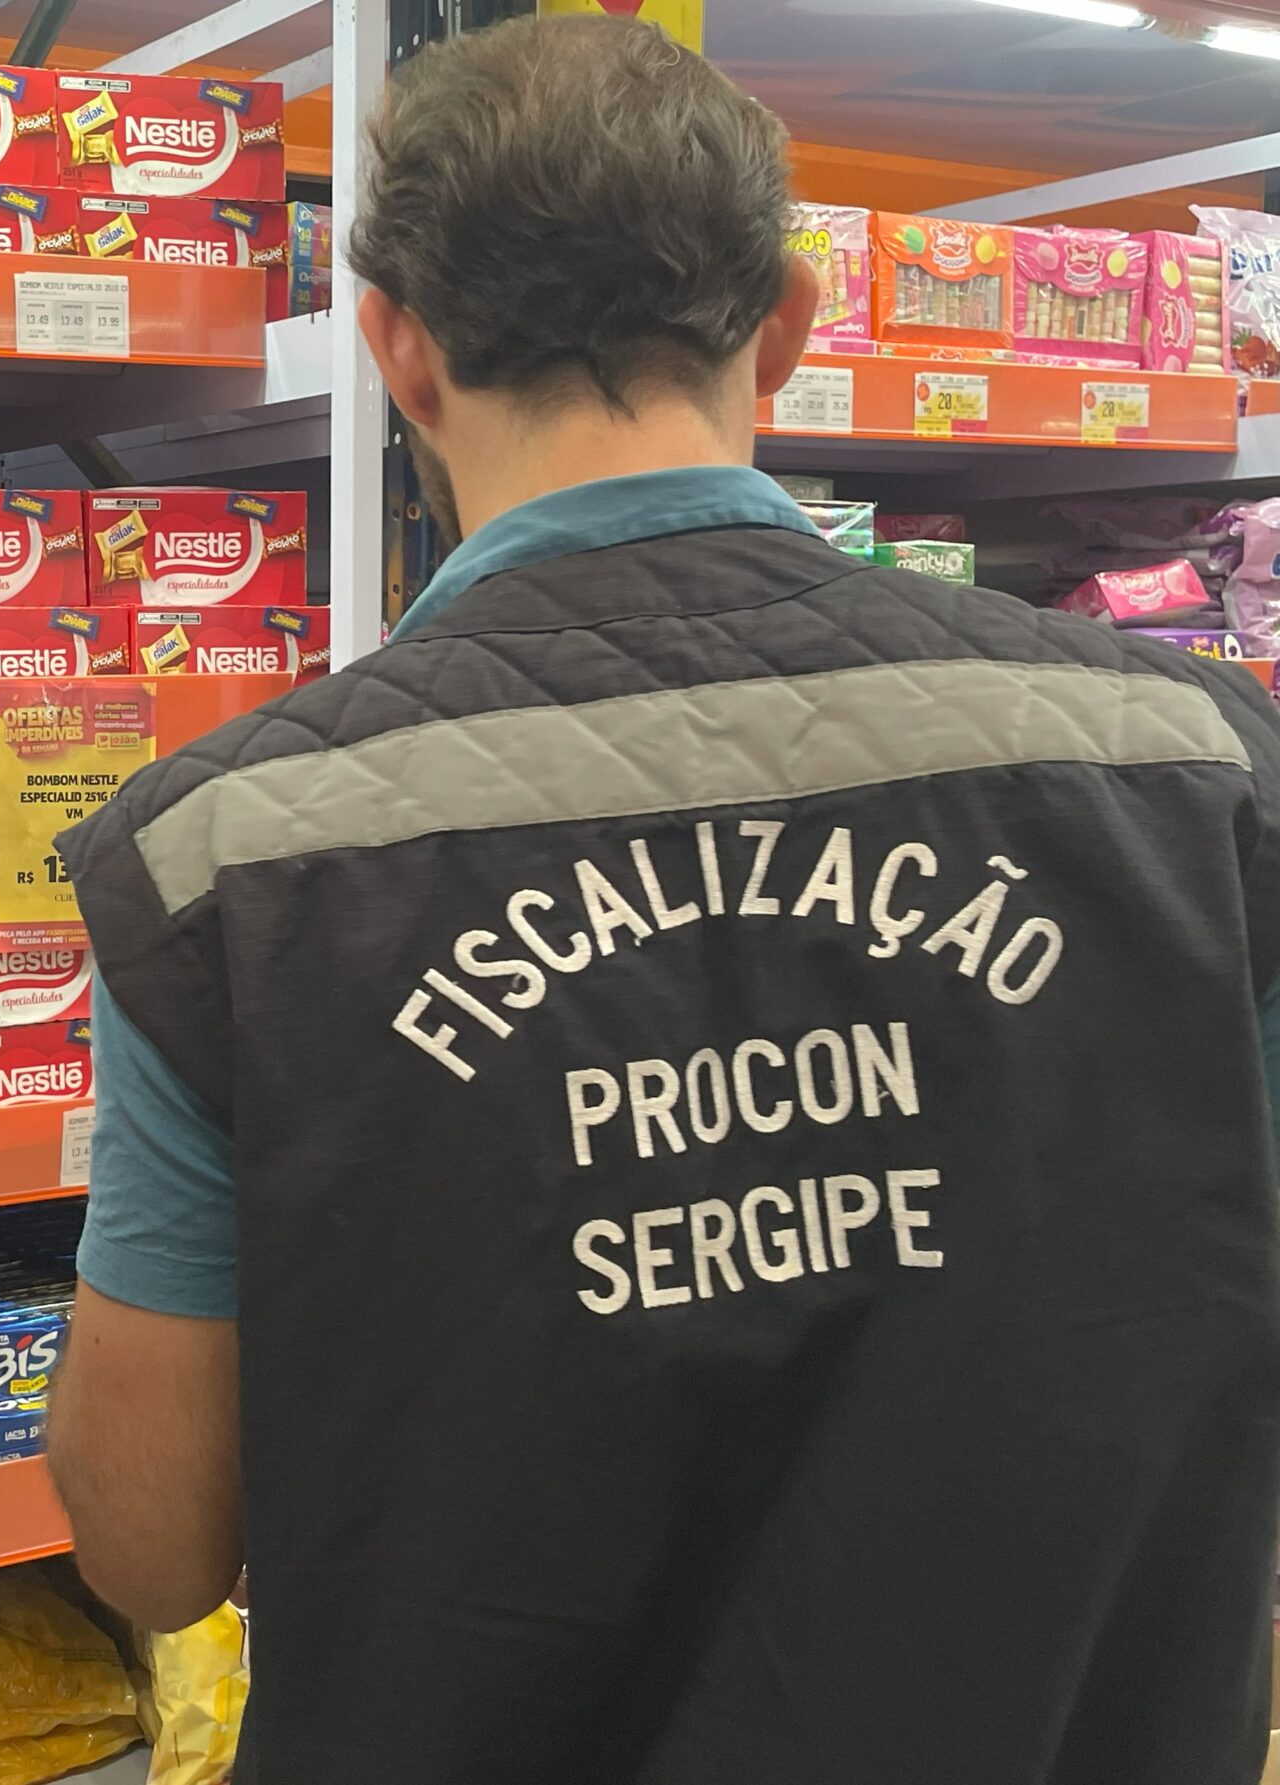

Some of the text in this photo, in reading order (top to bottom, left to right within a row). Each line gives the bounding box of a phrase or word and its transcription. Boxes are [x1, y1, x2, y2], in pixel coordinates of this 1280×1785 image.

[76, 103, 107, 126] Galak
[124, 115, 217, 149] Nestlé
[138, 167, 204, 181] especialidades
[97, 226, 126, 249] Galak
[143, 237, 228, 267] Nestlé
[26, 314, 49, 325] 13.49
[61, 315, 84, 326] 13.49
[107, 520, 136, 546] Galak
[154, 531, 242, 559] Nestlé
[166, 579, 229, 593] especialidades
[152, 637, 180, 661] Galak
[196, 646, 279, 673] Nestlé
[2, 705, 85, 728] OFERTAS
[4, 726, 85, 743] IMPERDÍVEIS
[26, 774, 119, 786] BOMBOM NESTLE
[20, 791, 109, 803] ESPECIALID 251G
[65, 808, 84, 819] VM
[16, 869, 34, 885] R$
[392, 820, 1063, 1083] FISCALIZAÇÃO
[1, 992, 63, 1011] especialidades
[564, 1020, 920, 1167] PROCON
[572, 1168, 944, 1315] SERGIPE
[4, 1428, 27, 1441] LACTA
